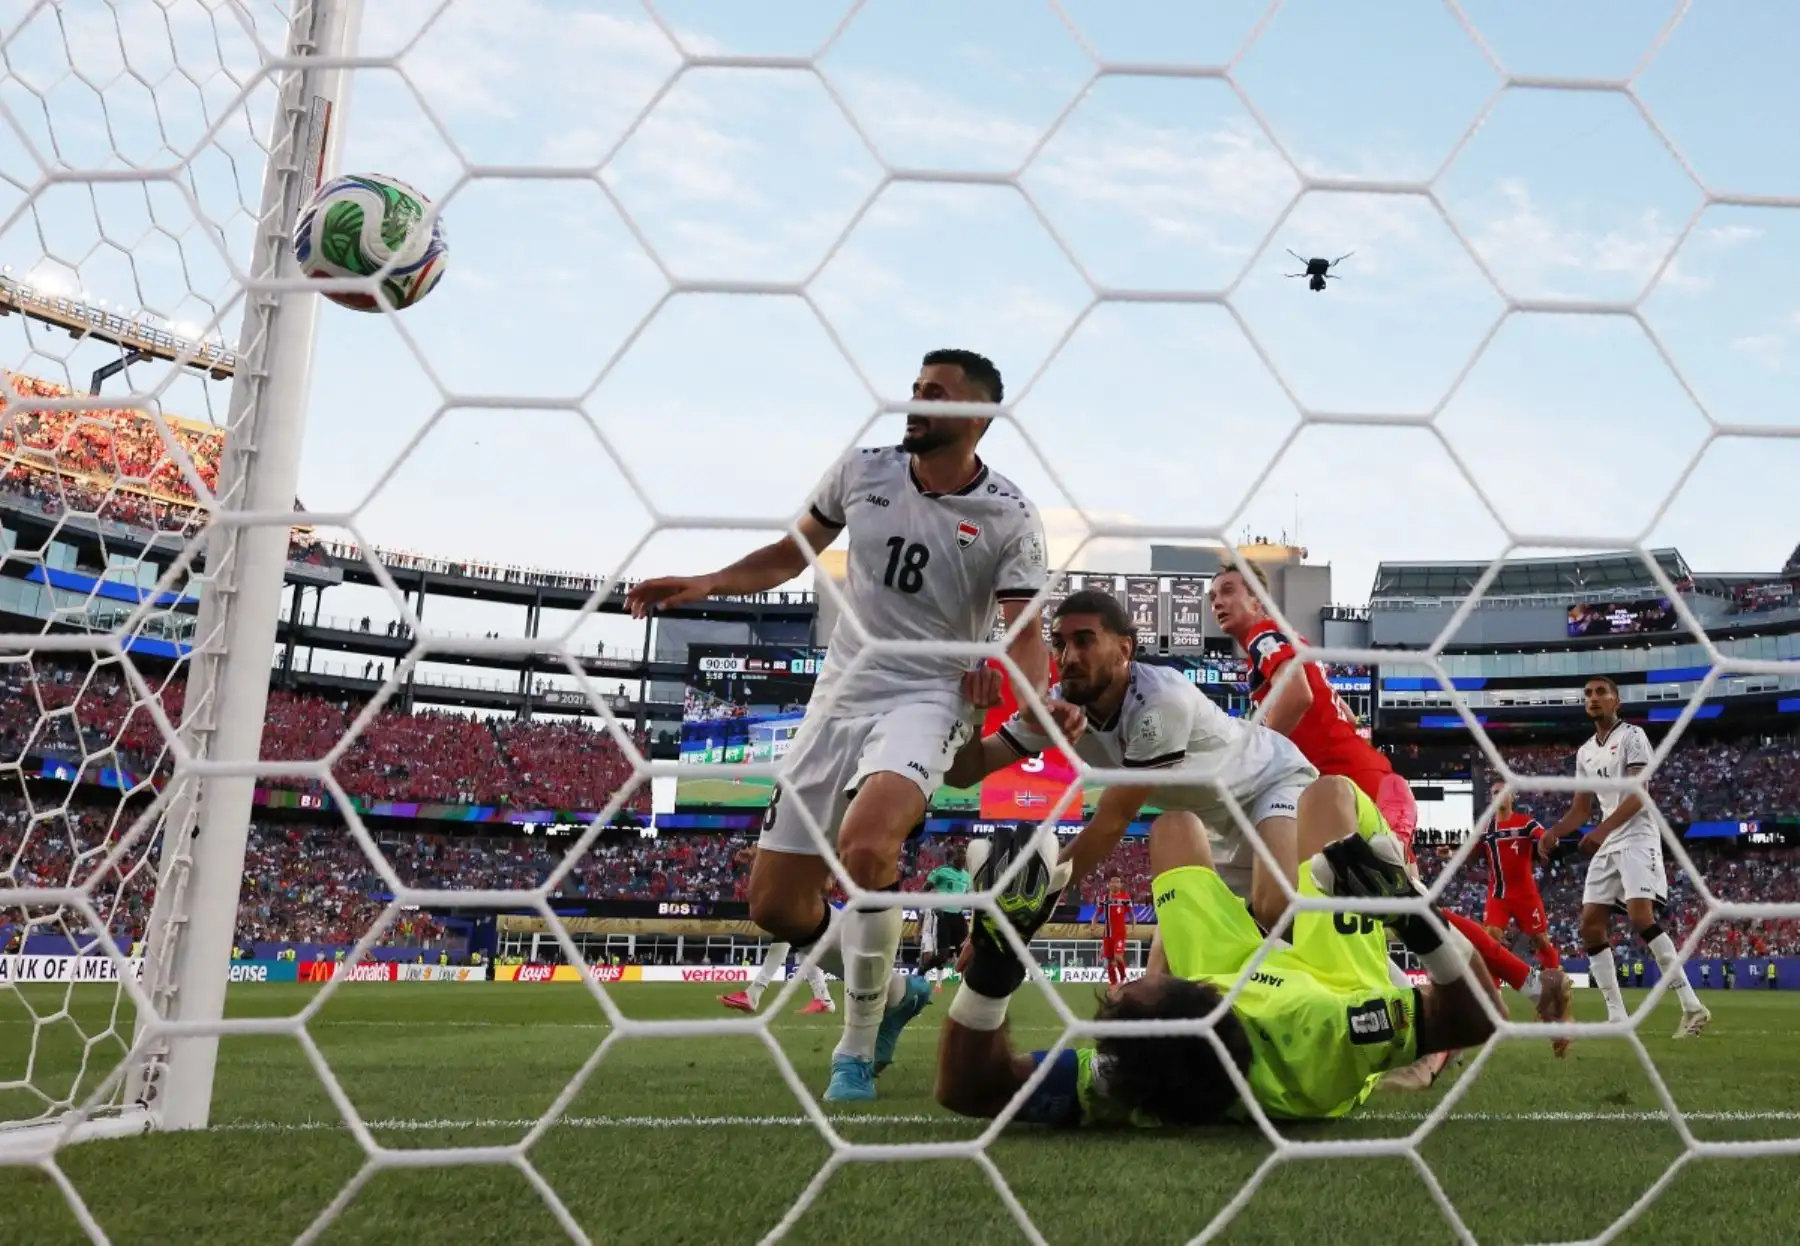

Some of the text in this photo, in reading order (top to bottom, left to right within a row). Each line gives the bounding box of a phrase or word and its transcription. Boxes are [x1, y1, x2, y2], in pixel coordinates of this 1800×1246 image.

[866, 494, 890, 508] JAKO
[884, 536, 930, 594] 18
[1136, 636, 1156, 644] 016
[1173, 637, 1199, 645] 2018
[706, 660, 737, 670] 90:00
[560, 693, 584, 704] 2021
[907, 761, 929, 780] JAKO
[973, 824, 995, 833] FIFA
[1510, 840, 1519, 855] 4
[1532, 908, 1541, 922] 4
[44, 959, 68, 979] OF
[228, 964, 268, 982] ense
[519, 965, 552, 983] Lay's
[682, 968, 748, 982] verizon
[1250, 972, 1285, 987] JAKO
